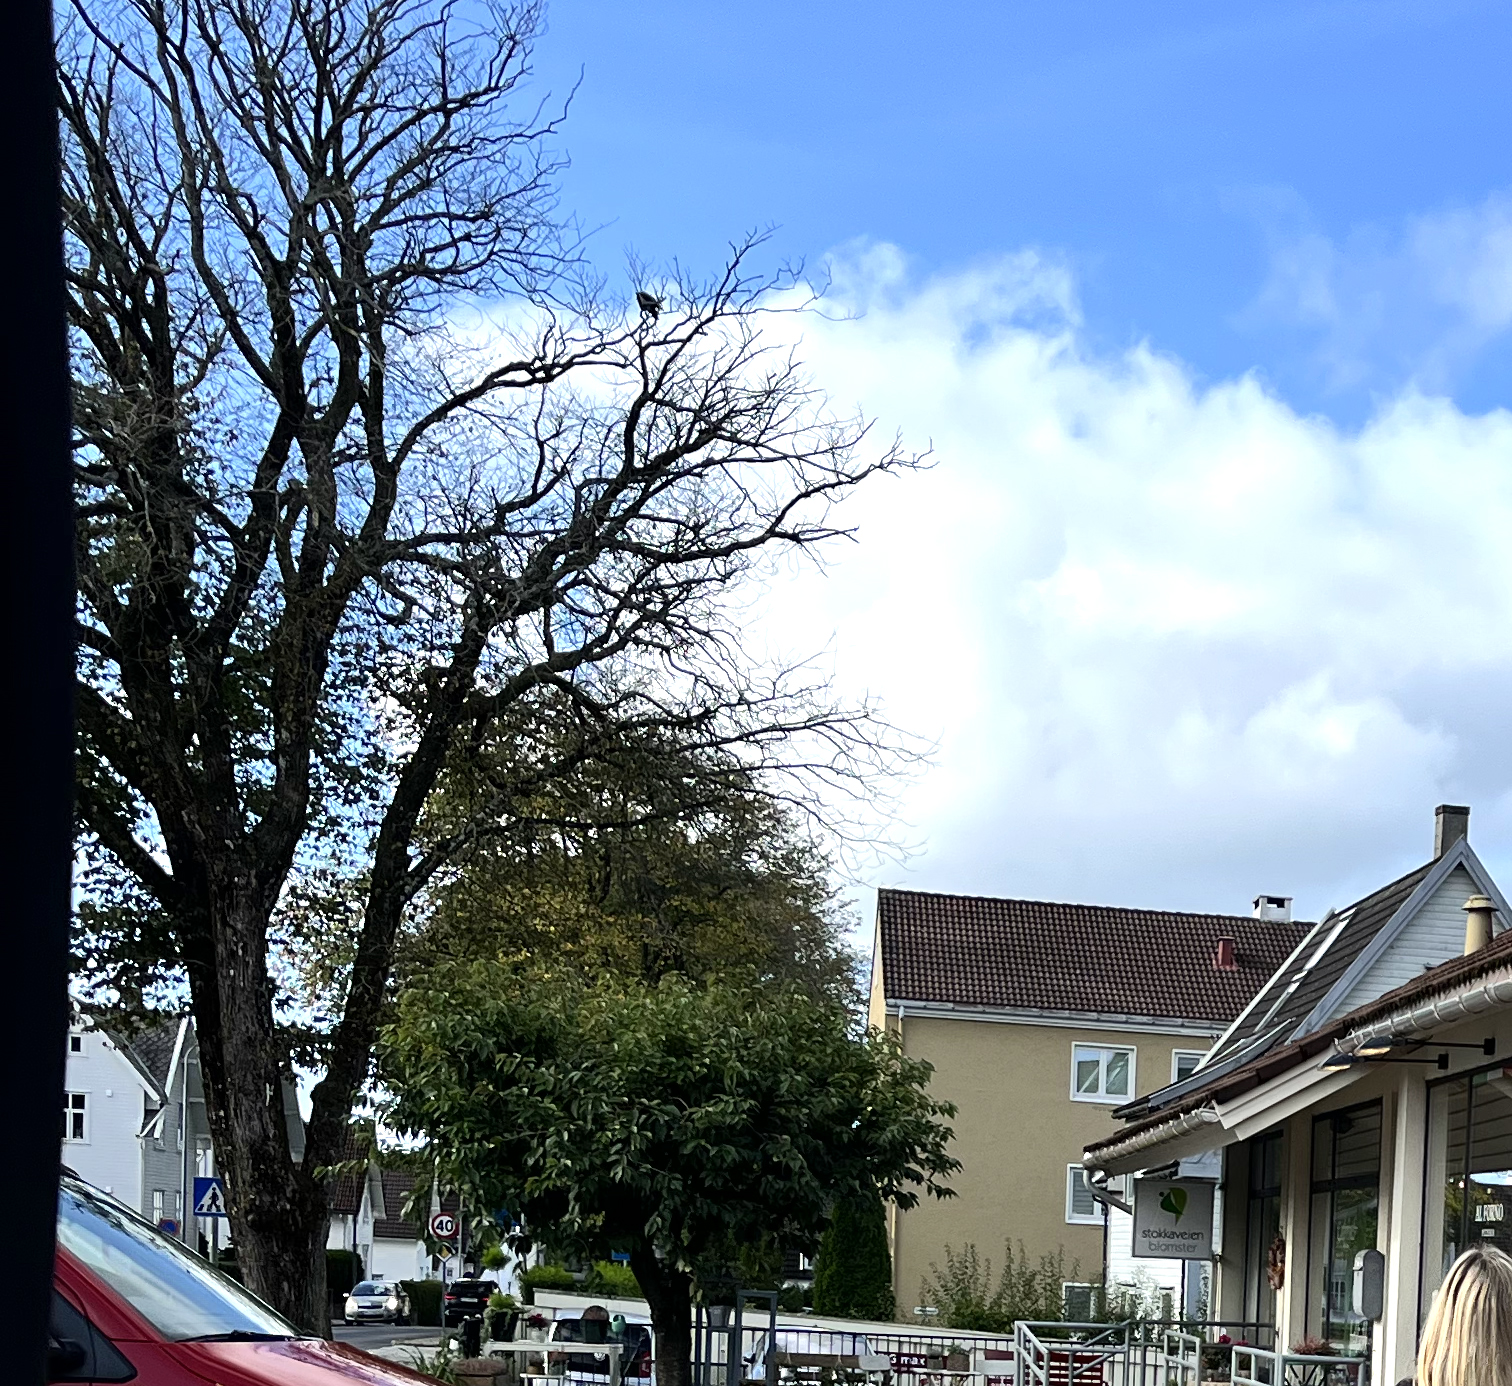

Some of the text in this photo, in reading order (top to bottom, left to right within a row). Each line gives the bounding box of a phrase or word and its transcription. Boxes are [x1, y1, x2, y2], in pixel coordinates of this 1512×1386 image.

[436, 1219, 453, 1232] 40
[1141, 1228, 1204, 1240] stokkaveien
[1148, 1240, 1198, 1252] blomster
